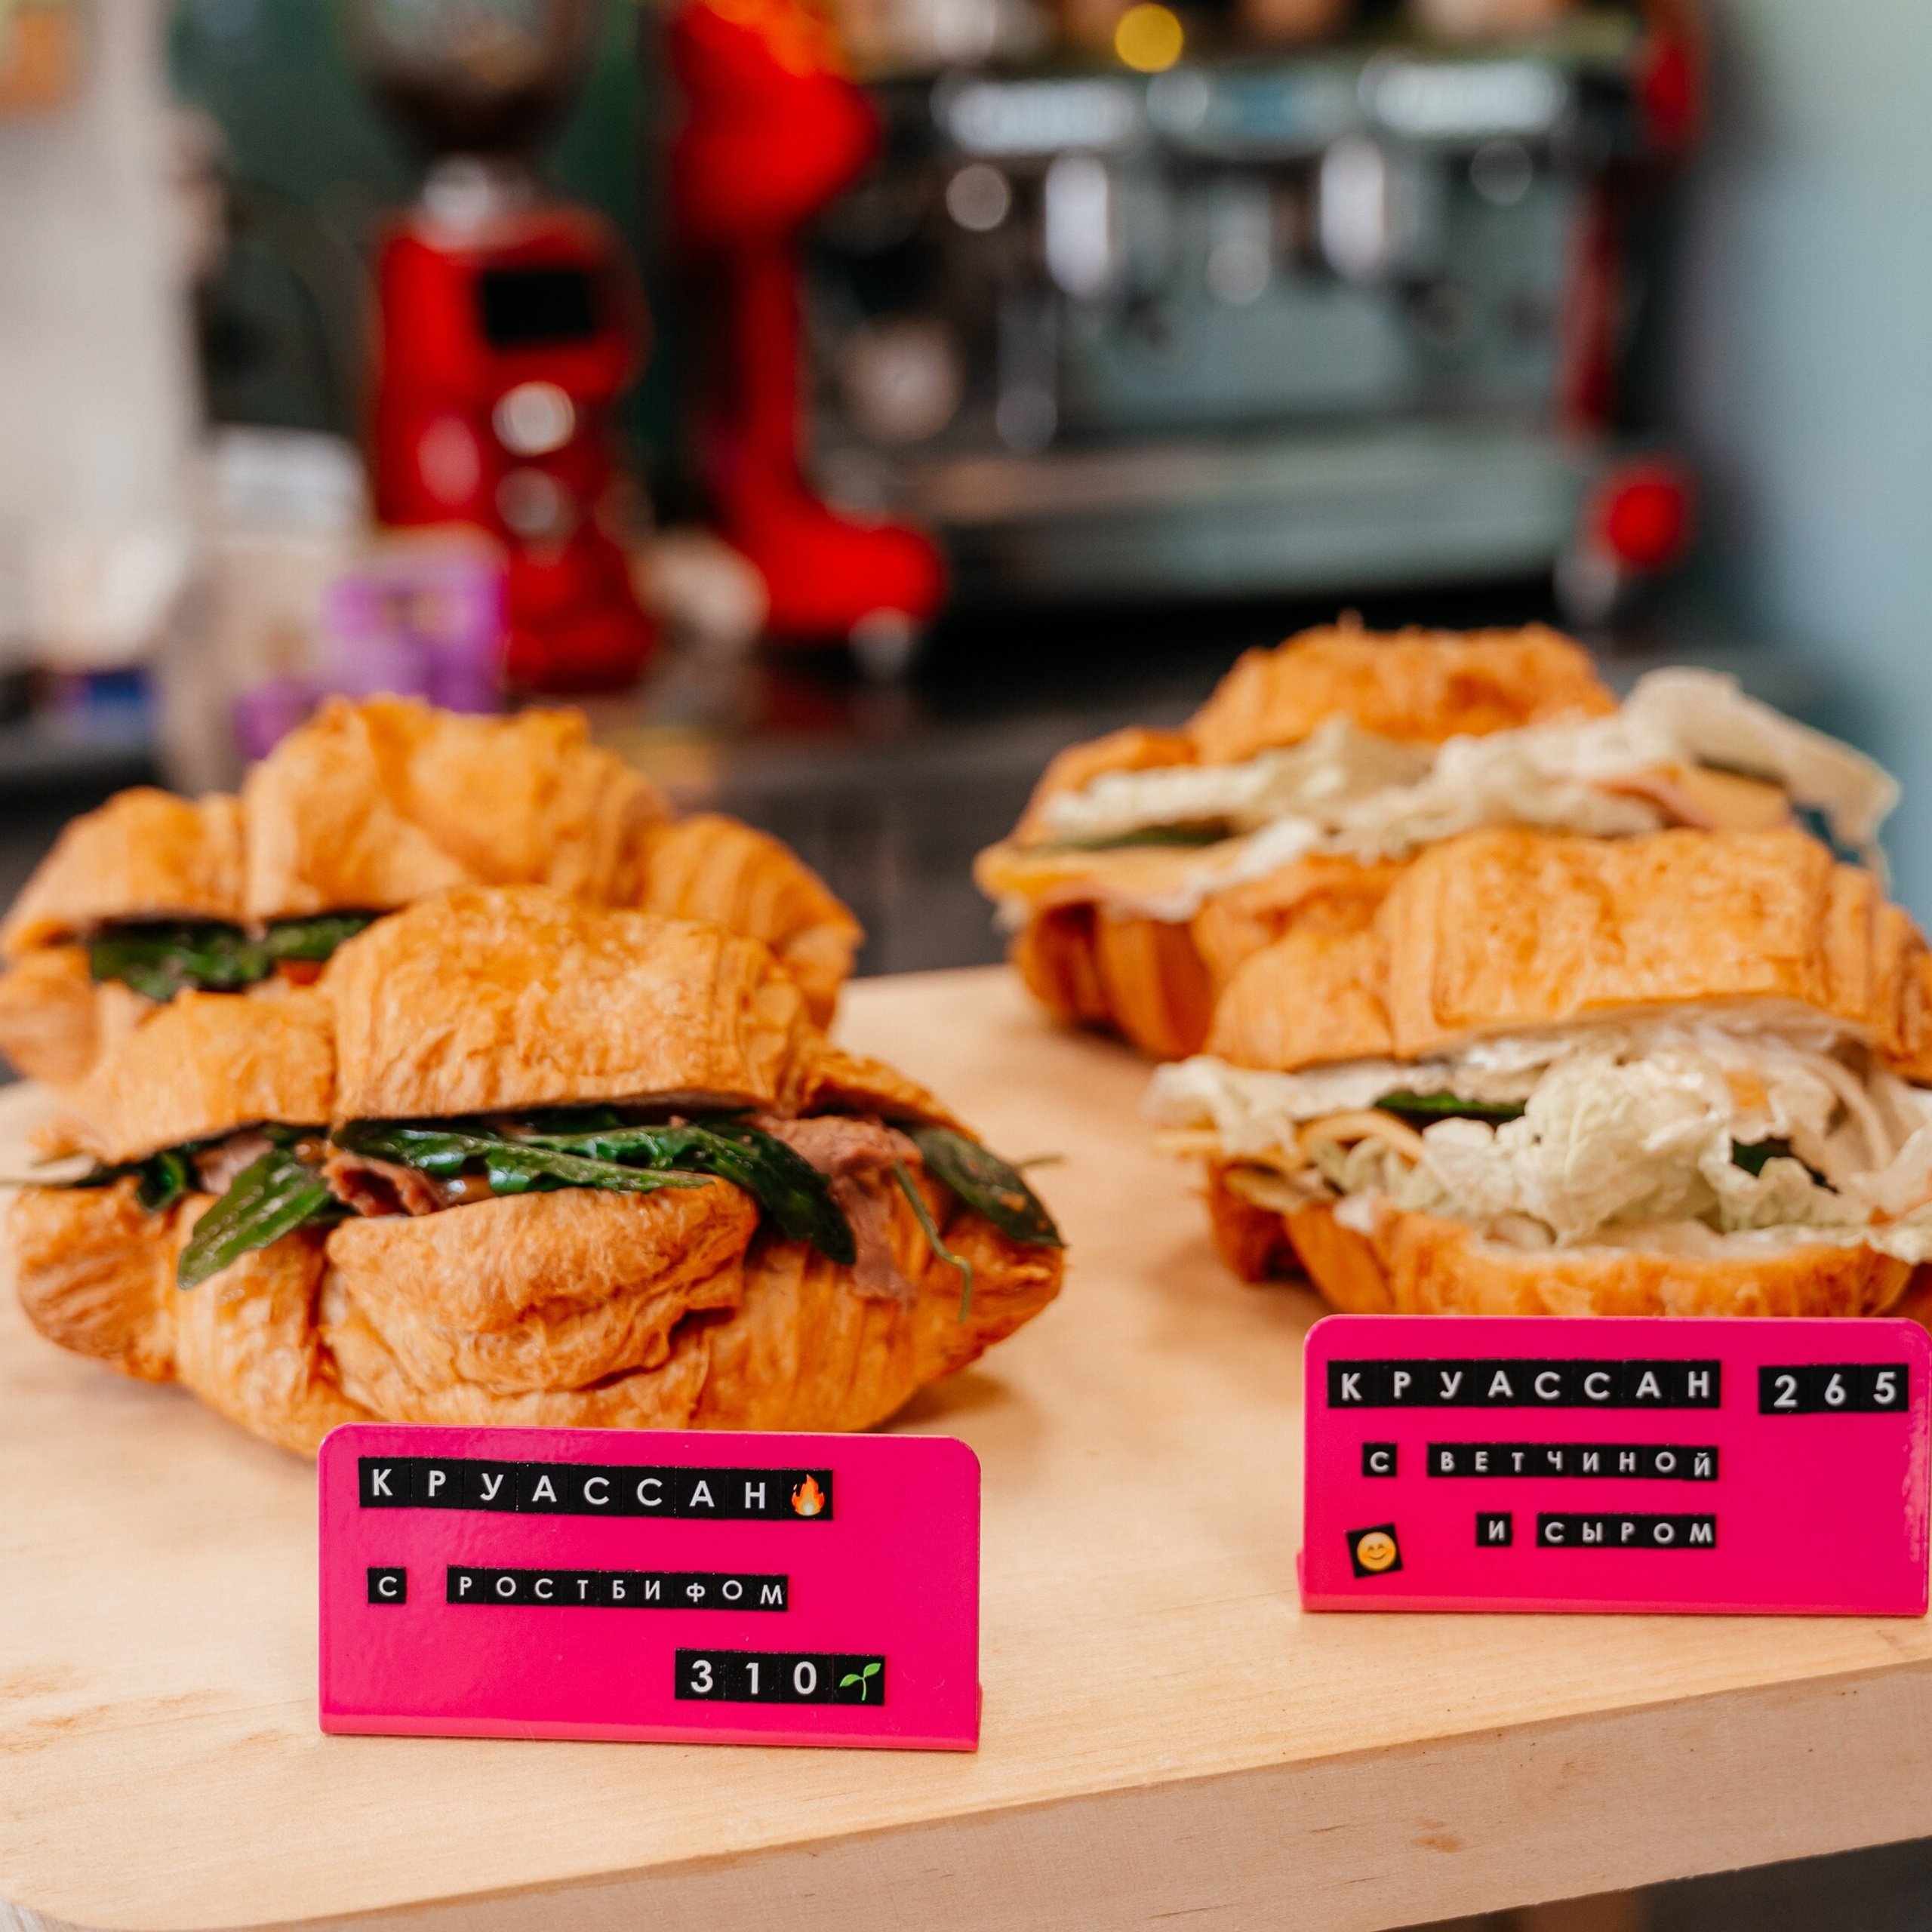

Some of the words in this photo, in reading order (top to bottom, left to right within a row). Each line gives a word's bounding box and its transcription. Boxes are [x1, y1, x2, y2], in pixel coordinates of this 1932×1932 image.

[1342, 1371, 1709, 1400] КРУАССАН
[1774, 1371, 1895, 1407] 265
[1370, 1451, 1389, 1472] С
[1441, 1451, 1710, 1476] ВЕТЧИНОЙ
[373, 1469, 765, 1509] КРУАССАН
[1489, 1520, 1504, 1540] И
[1545, 1521, 1712, 1543] СЫРОМ
[378, 1576, 398, 1597] С
[460, 1576, 783, 1604] РОСТБИФОМ
[691, 1660, 817, 1695] 310
